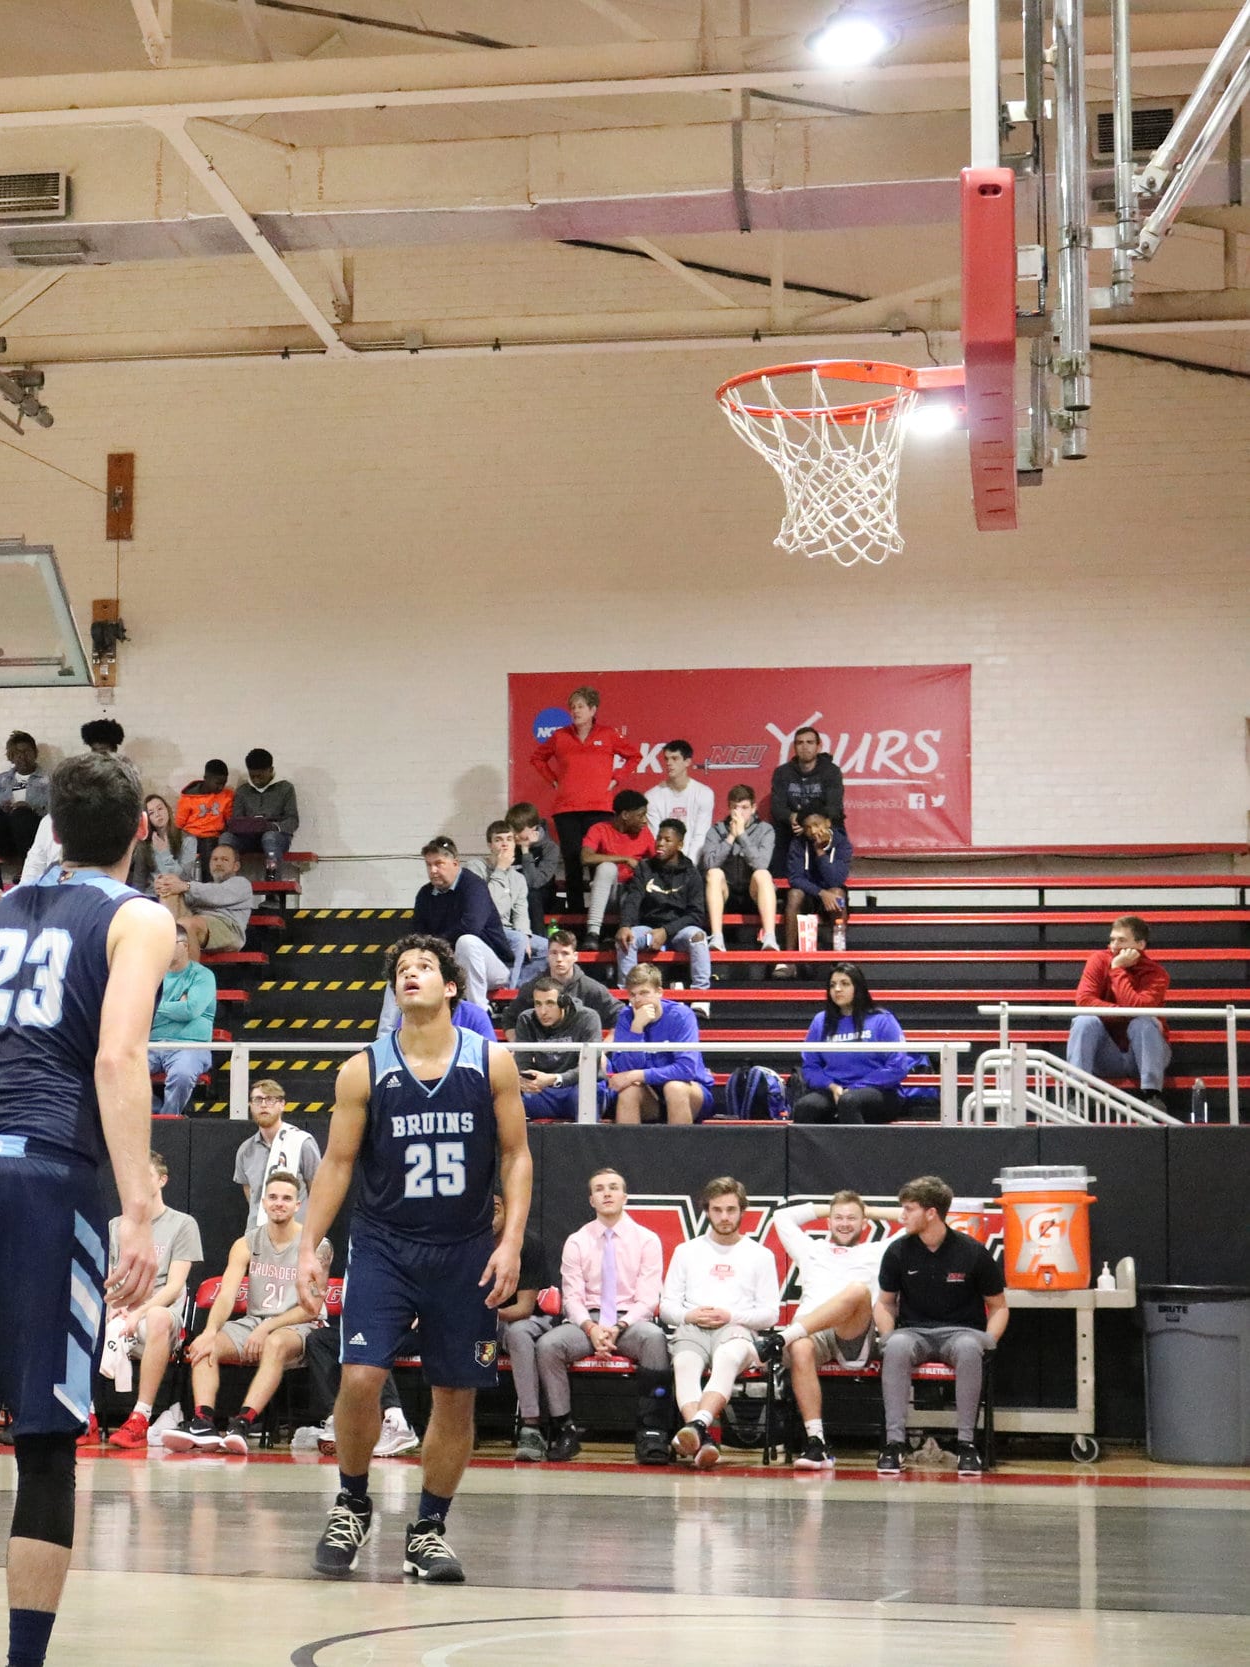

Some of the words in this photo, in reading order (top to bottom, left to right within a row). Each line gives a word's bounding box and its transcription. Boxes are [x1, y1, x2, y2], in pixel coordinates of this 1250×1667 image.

[711, 745, 769, 765] NGU
[765, 711, 941, 776] YURS
[391, 1112, 474, 1137] BRUINS
[404, 1142, 466, 1198] 25
[262, 1283, 284, 1309] 21
[1158, 1306, 1189, 1314] BRUTE
